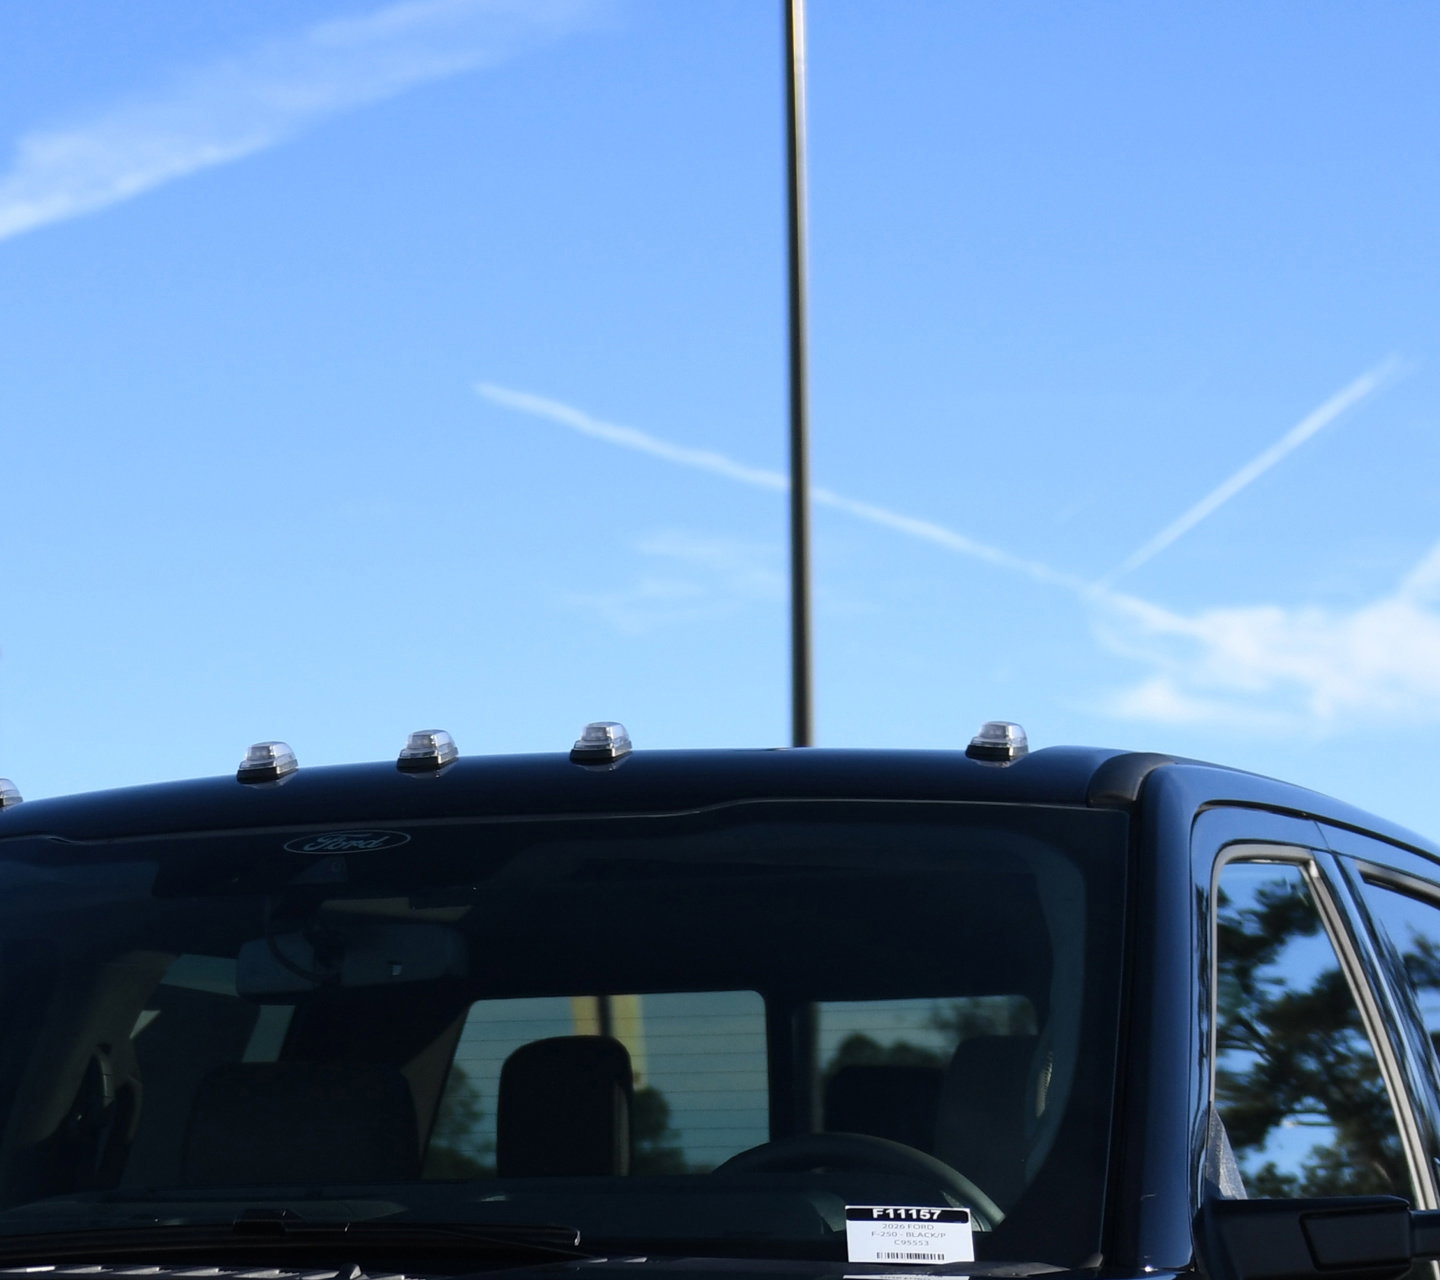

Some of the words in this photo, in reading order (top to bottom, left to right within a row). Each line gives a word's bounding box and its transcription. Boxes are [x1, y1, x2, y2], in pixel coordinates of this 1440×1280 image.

[303, 832, 391, 851] Ford
[872, 1208, 942, 1220] F11157
[907, 1223, 935, 1231] FORD
